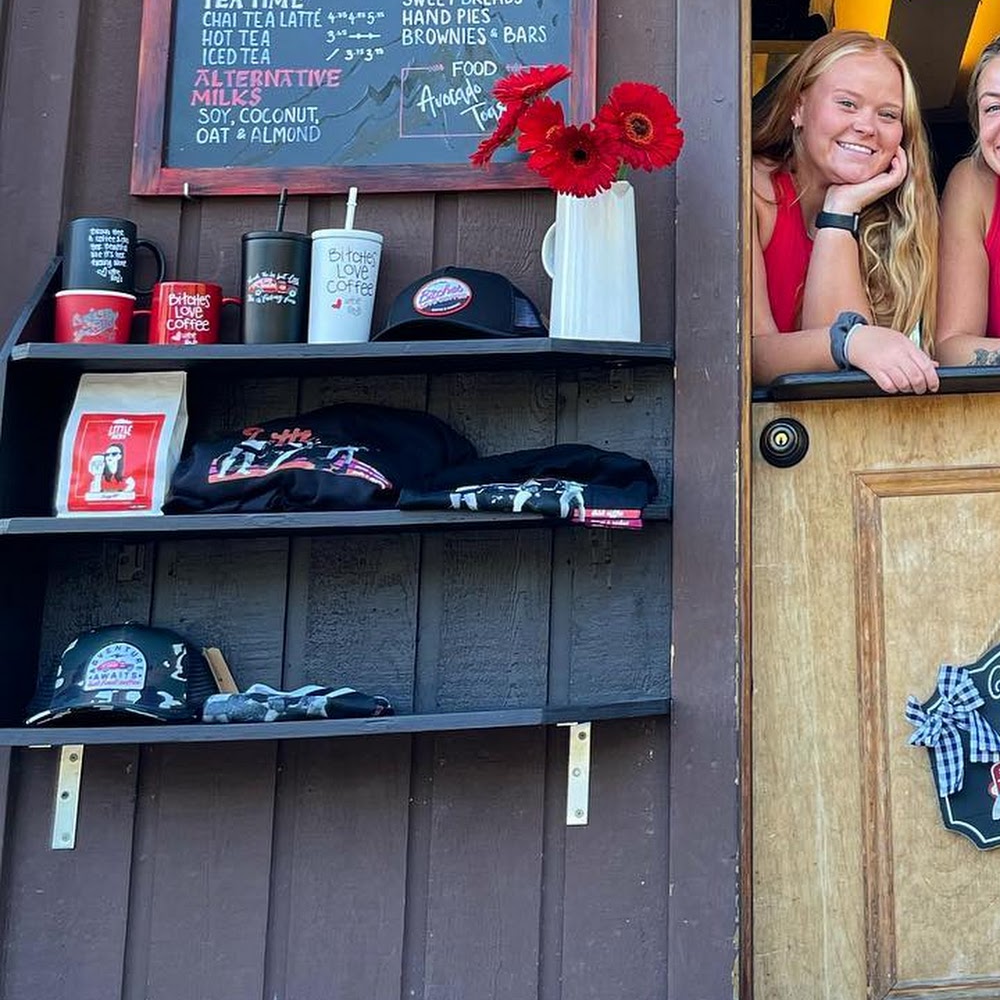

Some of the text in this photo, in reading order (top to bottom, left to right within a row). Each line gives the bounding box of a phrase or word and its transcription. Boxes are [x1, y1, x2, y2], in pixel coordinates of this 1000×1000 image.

[203, 12, 237, 27] CHAI
[243, 12, 275, 27] TEA
[403, 9, 491, 25] HAND PIES
[202, 30, 270, 46] HOT TEA
[403, 28, 486, 45] BROWNIES
[504, 26, 547, 43] BARS
[203, 48, 237, 65] ICED
[241, 49, 270, 64] TEA
[452, 61, 498, 77] FOOD
[194, 70, 342, 87] ALTERNATIVE
[191, 88, 262, 106] MILKS
[417, 79, 482, 118] Avocado
[198, 107, 319, 125] SOY, COCONUT,
[196, 127, 321, 144] OAT & ALMOND
